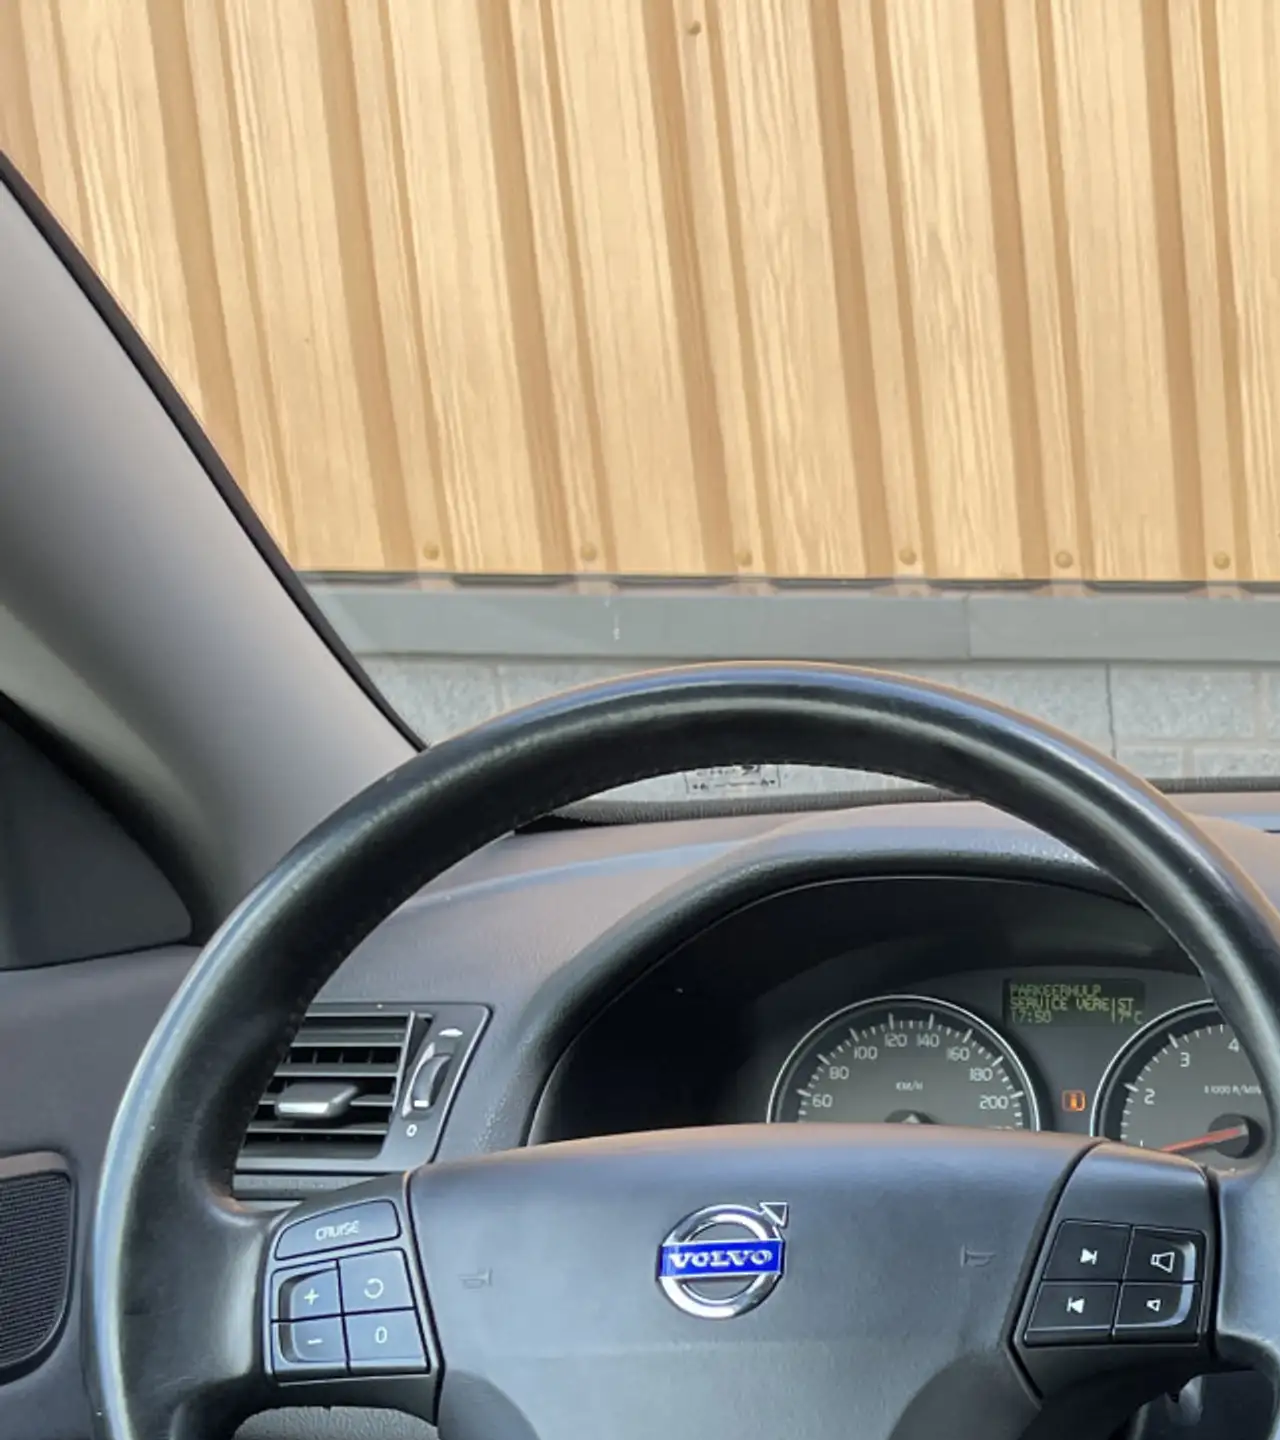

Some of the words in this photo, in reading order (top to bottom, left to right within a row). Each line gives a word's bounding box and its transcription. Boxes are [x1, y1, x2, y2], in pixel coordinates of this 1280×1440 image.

[1010, 1010, 1052, 1024] 17:50
[884, 1033, 908, 1048] 120
[916, 1033, 940, 1048] 140
[1228, 1038, 1240, 1052] 4
[853, 1046, 878, 1060] 100
[946, 1047, 970, 1062] 160
[1180, 1052, 1191, 1068] 3
[829, 1066, 850, 1080] 80
[969, 1066, 993, 1081] 180
[812, 1094, 833, 1108] 60
[979, 1095, 1009, 1110] 200
[1144, 1088, 1156, 1105] 2
[315, 1220, 360, 1241] CRUISE
[668, 1249, 774, 1269] VOLVO
